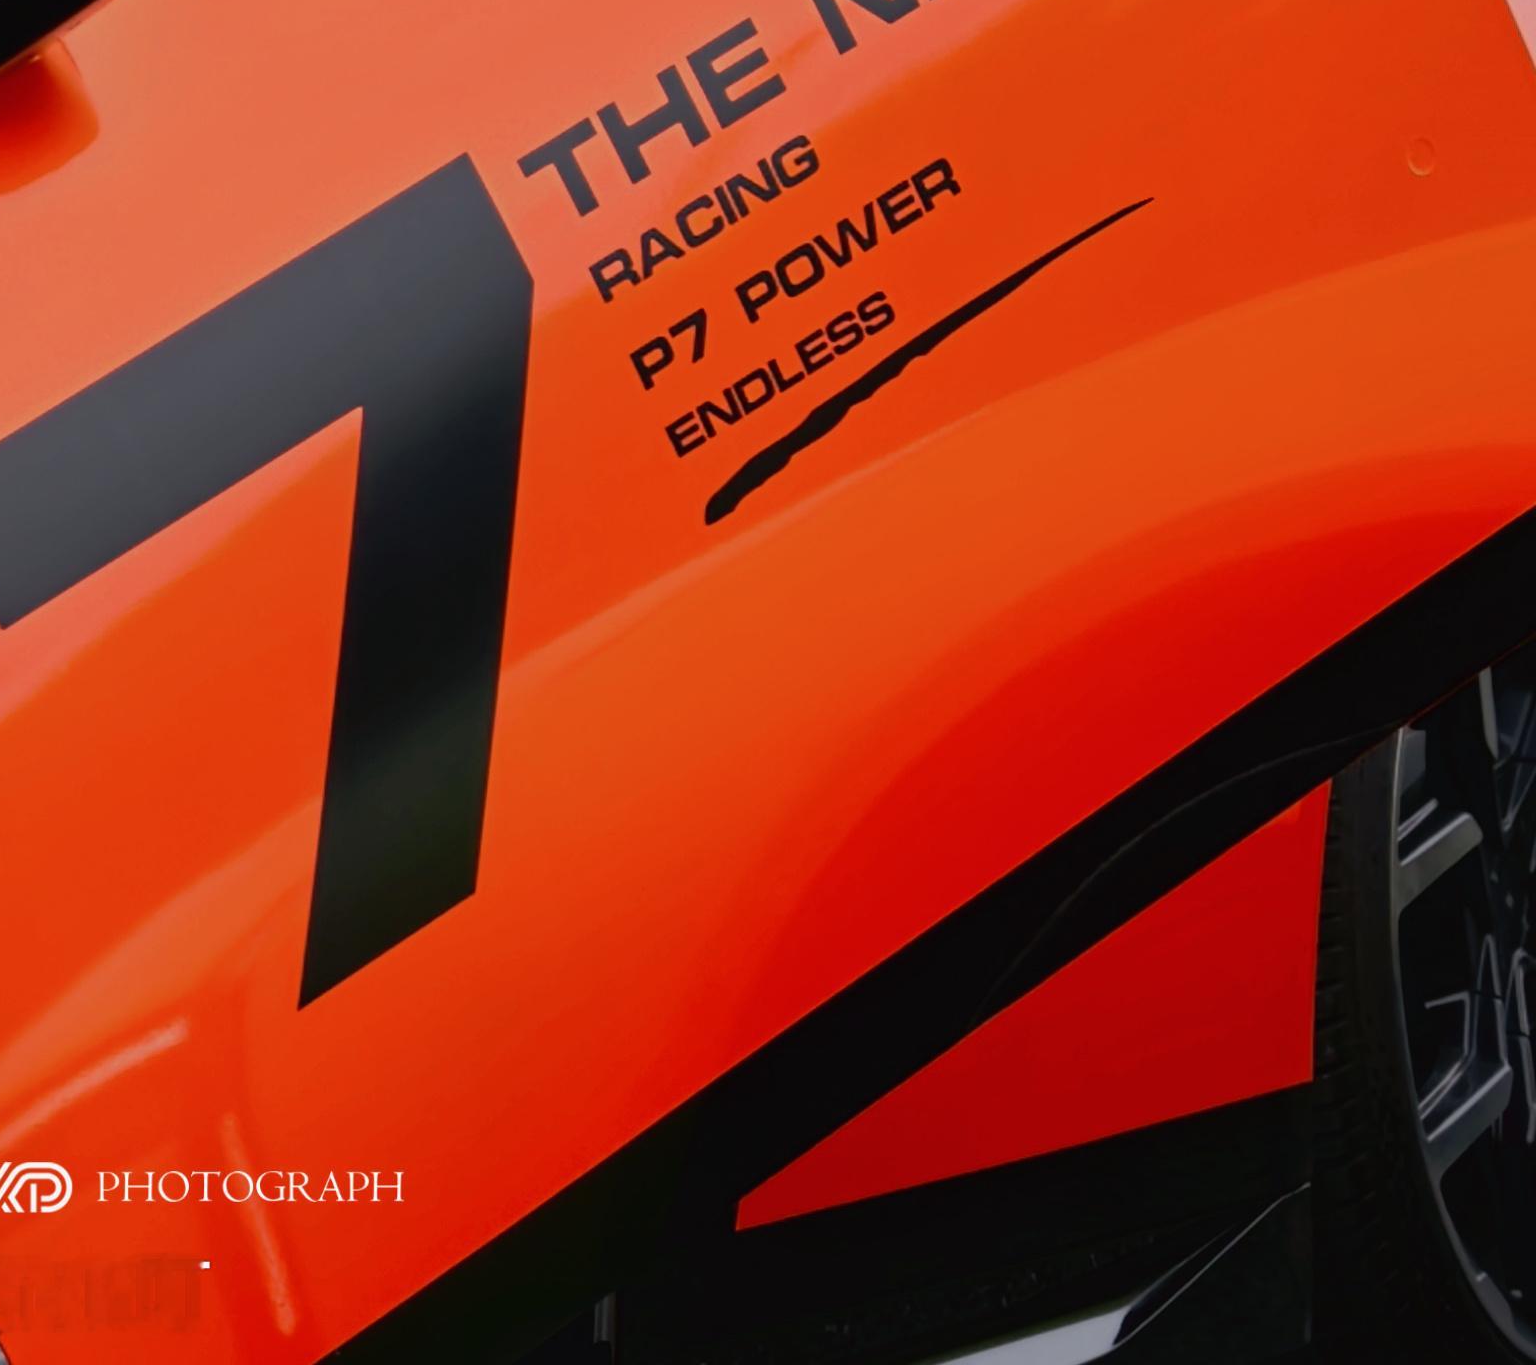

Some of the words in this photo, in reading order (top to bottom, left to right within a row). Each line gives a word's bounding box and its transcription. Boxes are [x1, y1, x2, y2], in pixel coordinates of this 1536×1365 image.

[517, 17, 787, 217] THE
[588, 135, 820, 303] RACING
[629, 307, 709, 390] P7
[735, 157, 962, 323] POWER
[664, 291, 897, 457] ENDLESS
